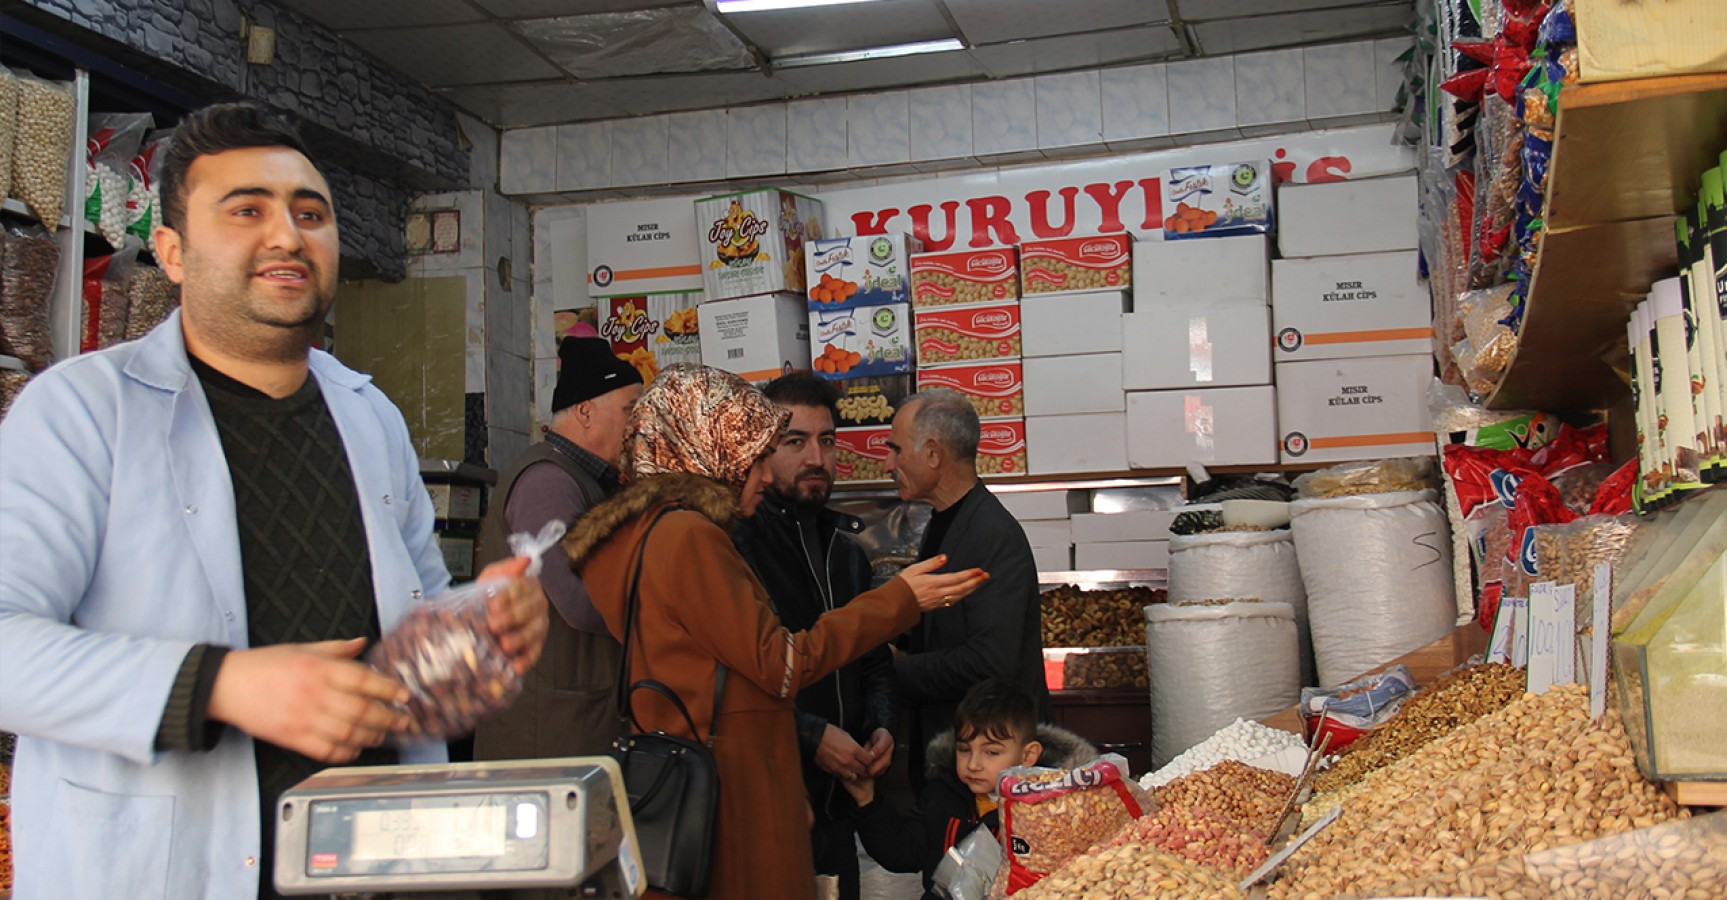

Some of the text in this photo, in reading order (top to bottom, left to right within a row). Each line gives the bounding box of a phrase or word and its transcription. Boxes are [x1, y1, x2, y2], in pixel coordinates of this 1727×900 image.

[637, 224, 659, 232] MISIR
[709, 220, 735, 247] Joy
[626, 231, 671, 243] KÜLAH CİPS
[1336, 281, 1363, 290] MISIR
[1323, 290, 1377, 302] KÜLAH CİPS
[602, 316, 627, 342] Joy
[1341, 385, 1368, 395] MISIR
[1328, 395, 1383, 407] KÜLAH CİPS
